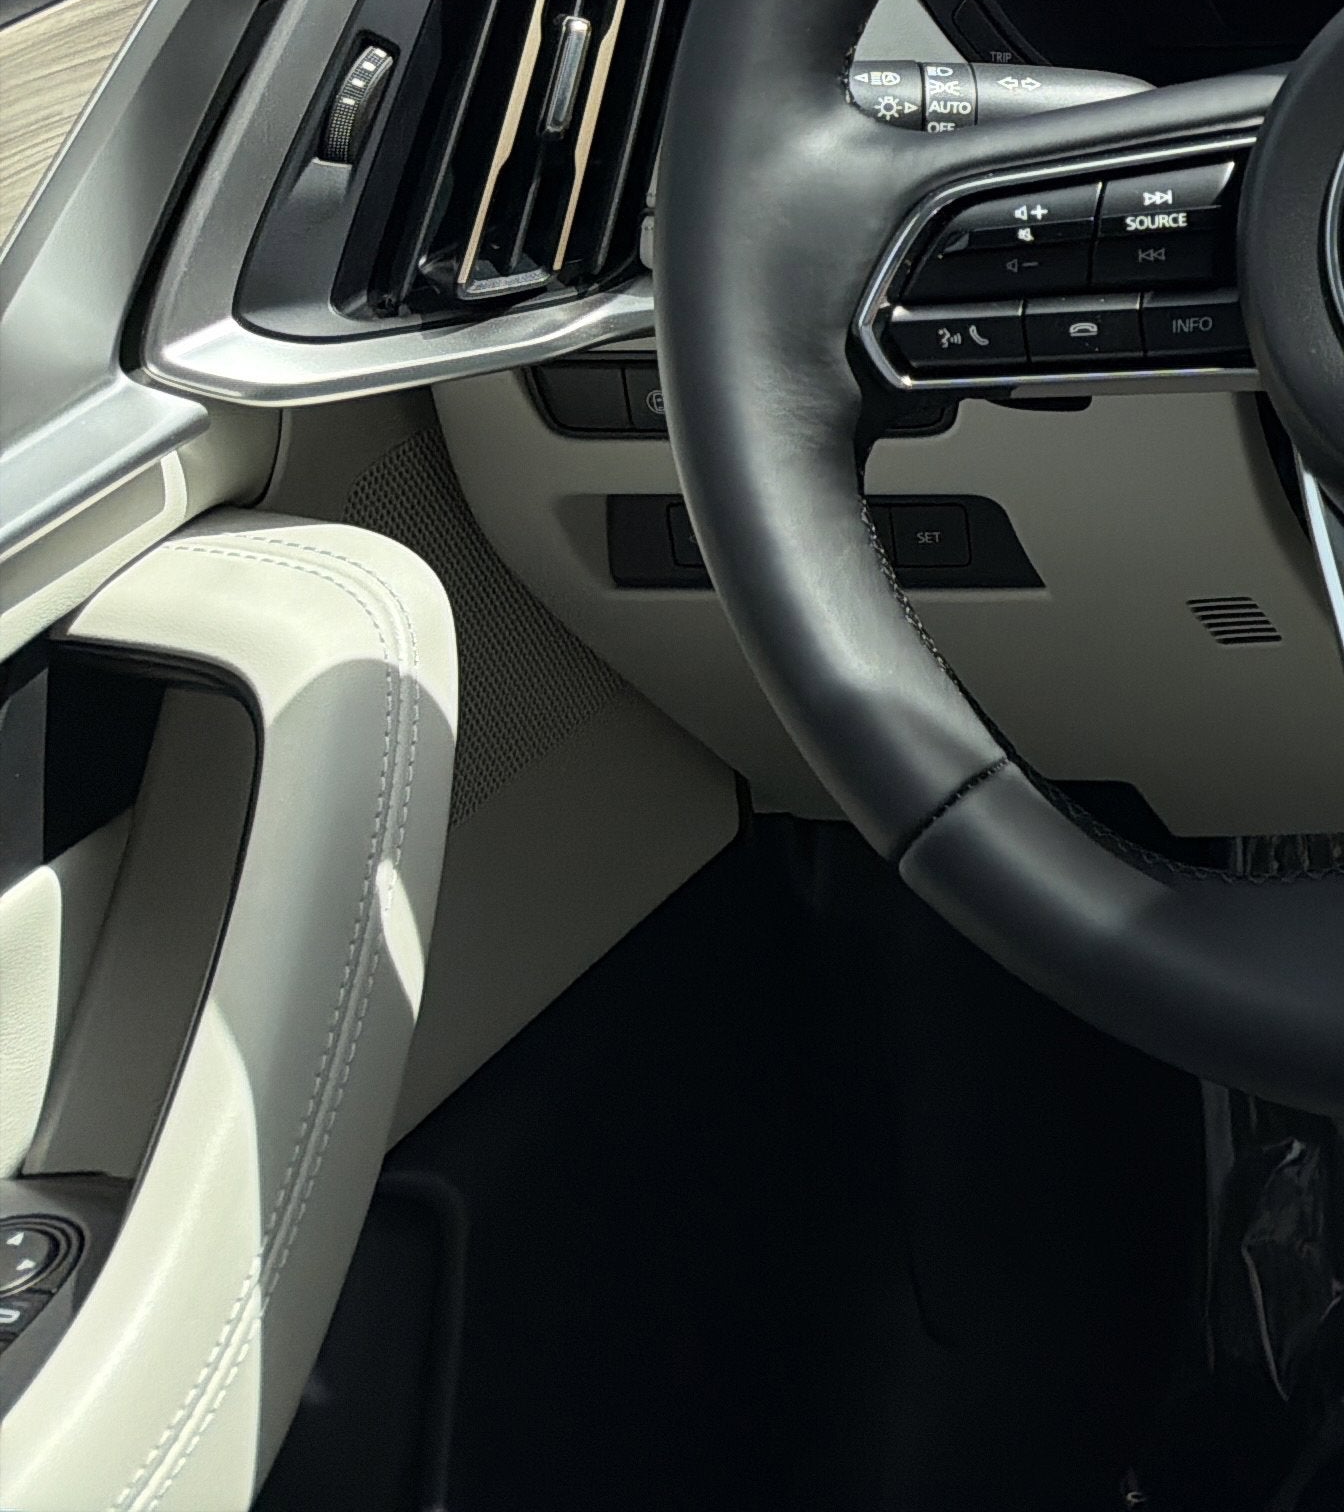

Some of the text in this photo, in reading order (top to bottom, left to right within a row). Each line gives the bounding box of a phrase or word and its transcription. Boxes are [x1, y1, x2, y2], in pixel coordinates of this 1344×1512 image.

[990, 51, 1012, 63] TRIP
[929, 100, 971, 115] AUTO
[927, 121, 955, 133] OFF
[1125, 212, 1188, 231] SOURCE
[1172, 316, 1213, 334] INFO
[916, 531, 942, 544] SET
